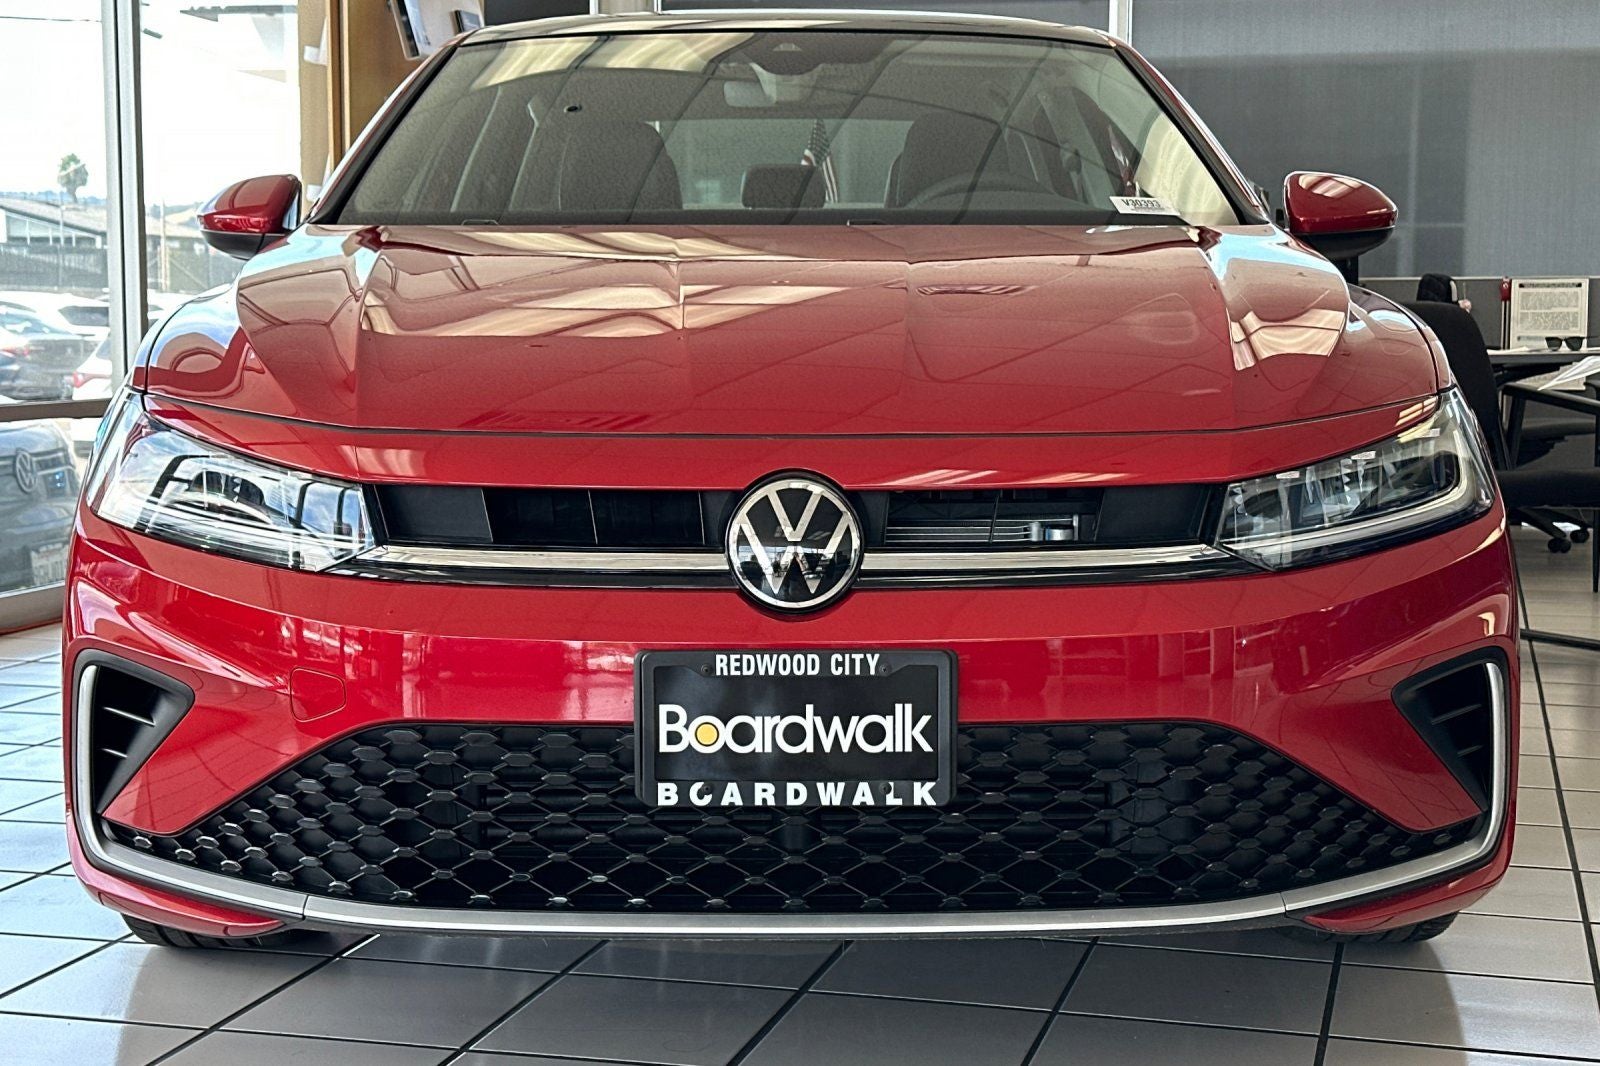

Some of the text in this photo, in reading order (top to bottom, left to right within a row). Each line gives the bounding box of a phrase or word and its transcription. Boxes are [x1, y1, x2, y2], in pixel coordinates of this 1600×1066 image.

[731, 484, 855, 599] VW
[715, 654, 880, 676] REDWOOD CITY
[658, 703, 933, 754] Boardwalk
[657, 782, 937, 806] BOARDWALK
